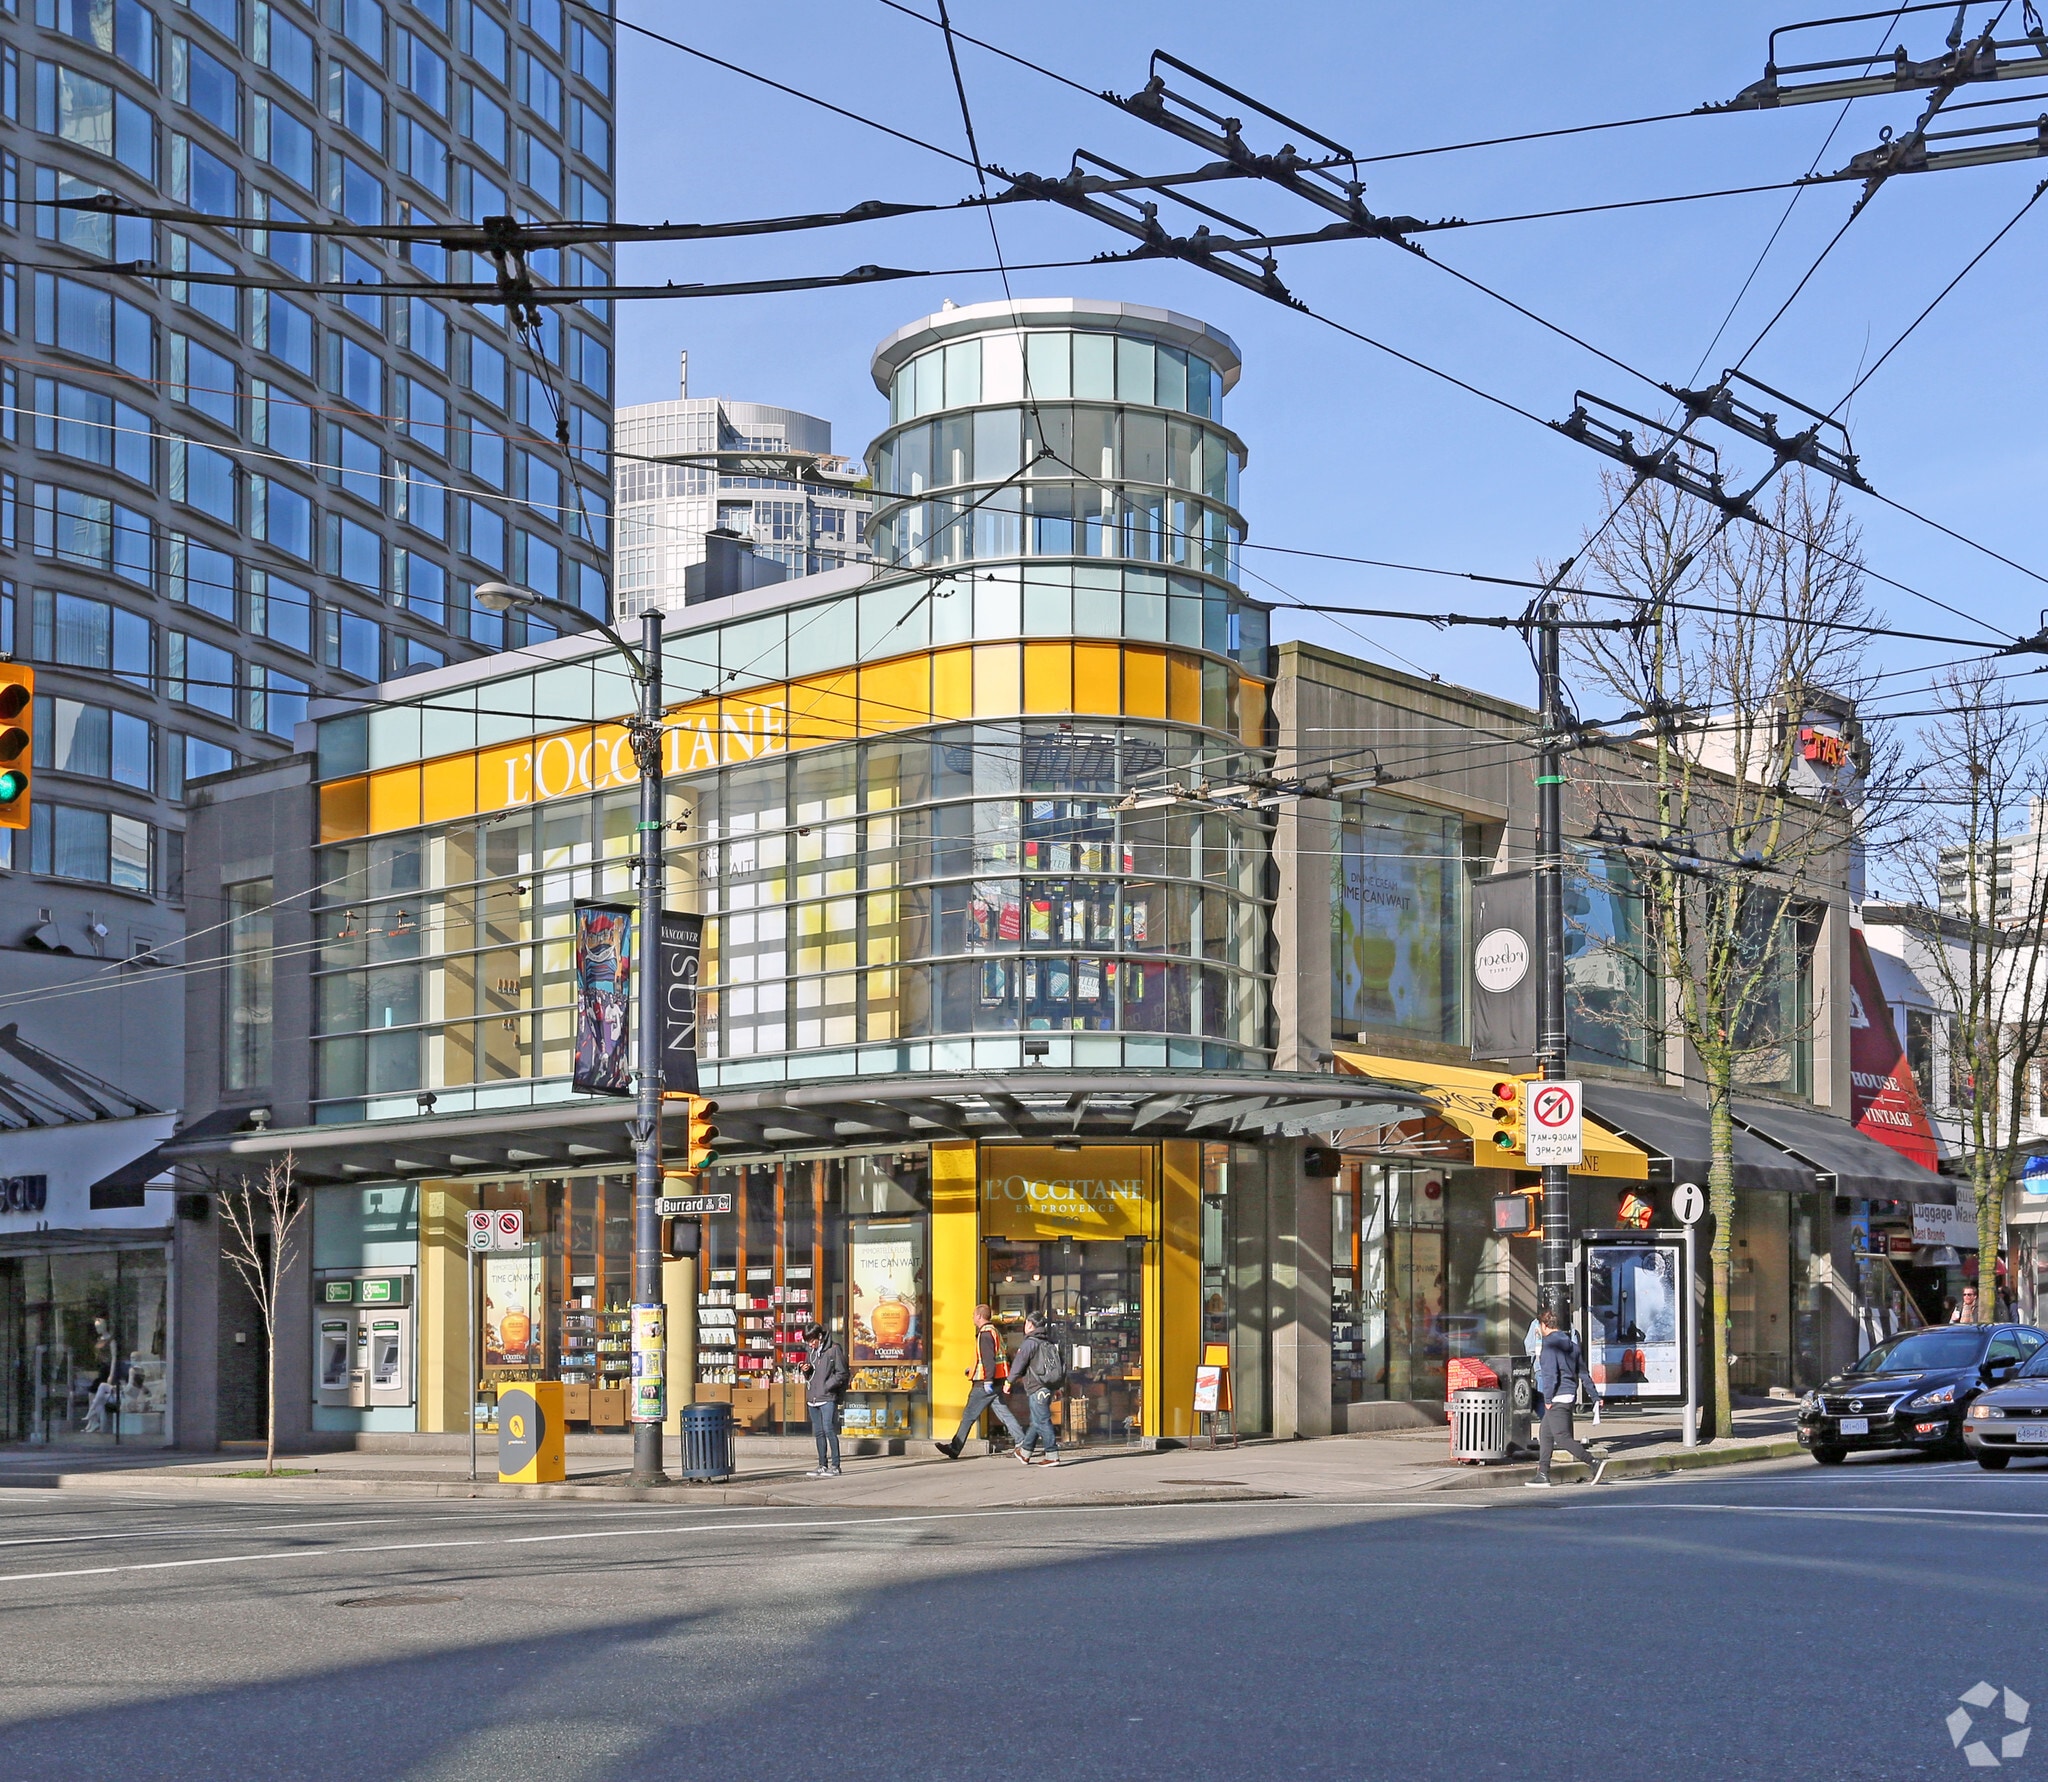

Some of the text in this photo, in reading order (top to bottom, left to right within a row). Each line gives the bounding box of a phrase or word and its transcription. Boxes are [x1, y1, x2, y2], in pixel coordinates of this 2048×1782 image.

[504, 701, 786, 807] L'OCCTANE
[1362, 889, 1385, 905] CAN
[1386, 894, 1410, 910] WAIT
[661, 926, 698, 943] VANCOUVER
[667, 952, 700, 1053] SUN
[1851, 1070, 1900, 1092] HOUSE
[1863, 1107, 1913, 1128] VINTAGE
[985, 1175, 1146, 1201] L'OCCITANE
[663, 1197, 703, 1213] Burrard
[1015, 1205, 1115, 1213] EN PROVENCE
[1913, 1203, 1953, 1224] Luggage
[860, 1257, 920, 1268] TIME CAN WAIT
[492, 1273, 540, 1283] TIME CAN WAIT
